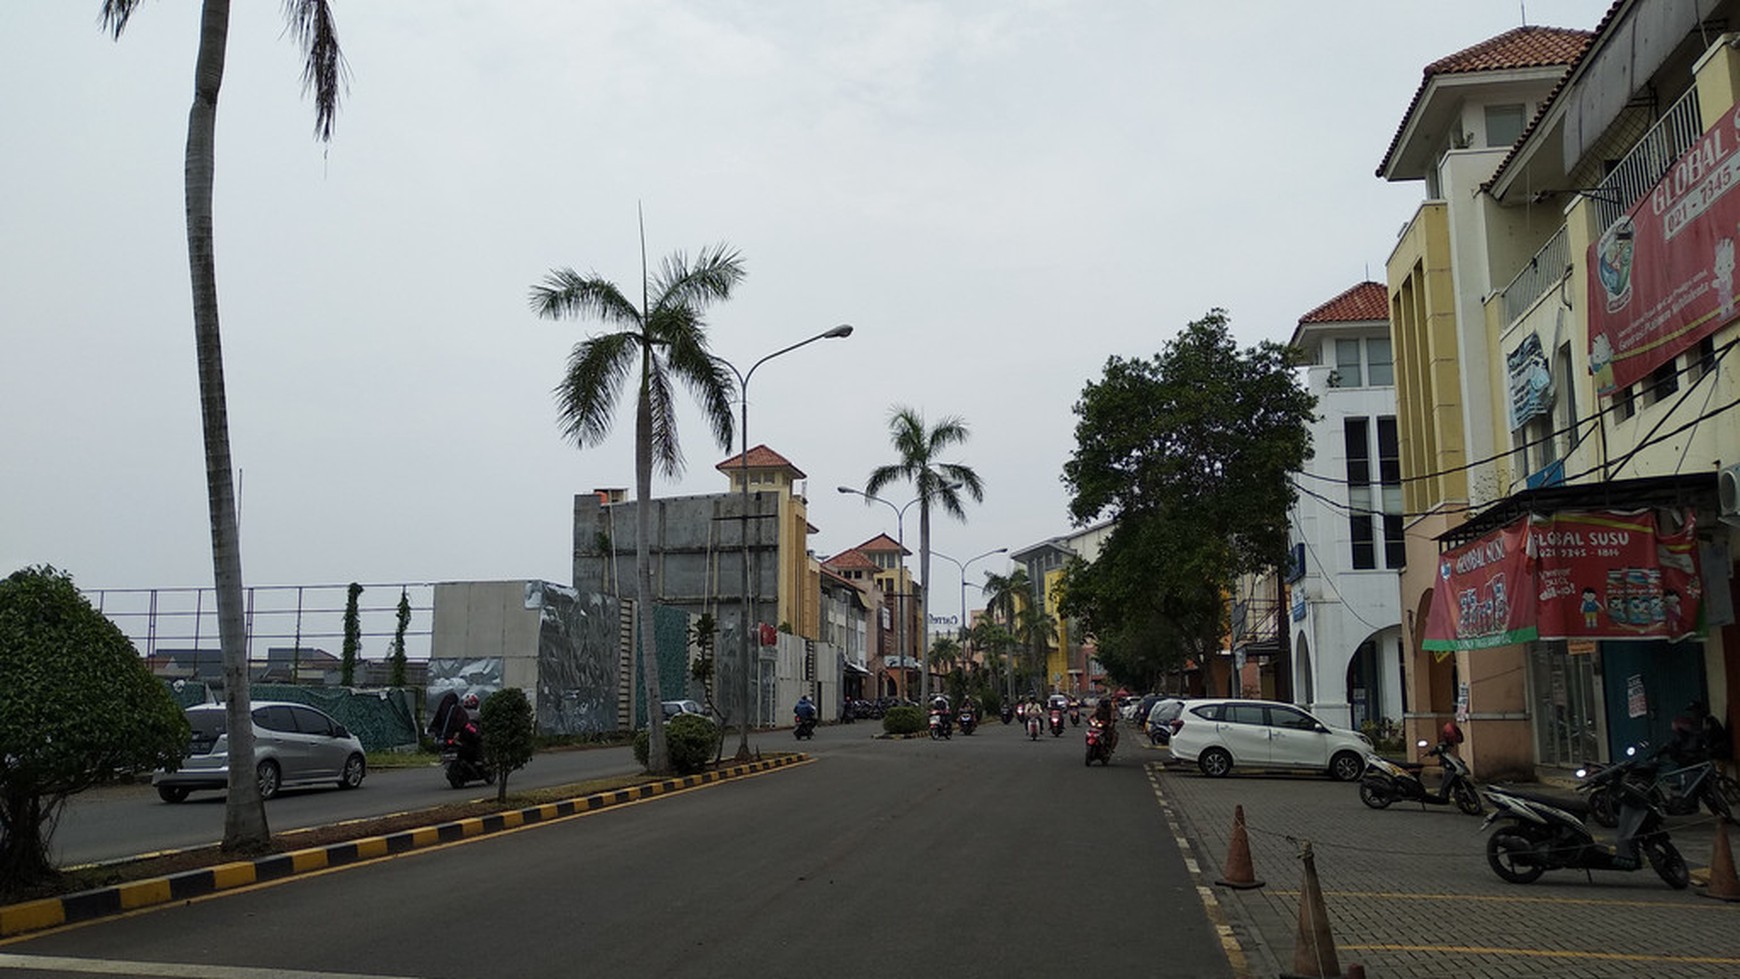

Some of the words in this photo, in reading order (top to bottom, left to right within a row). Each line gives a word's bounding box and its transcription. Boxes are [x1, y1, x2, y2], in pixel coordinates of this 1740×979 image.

[1652, 128, 1729, 215] GLOBAL
[1668, 203, 1687, 232] 021
[1588, 531, 1630, 546] SUSU
